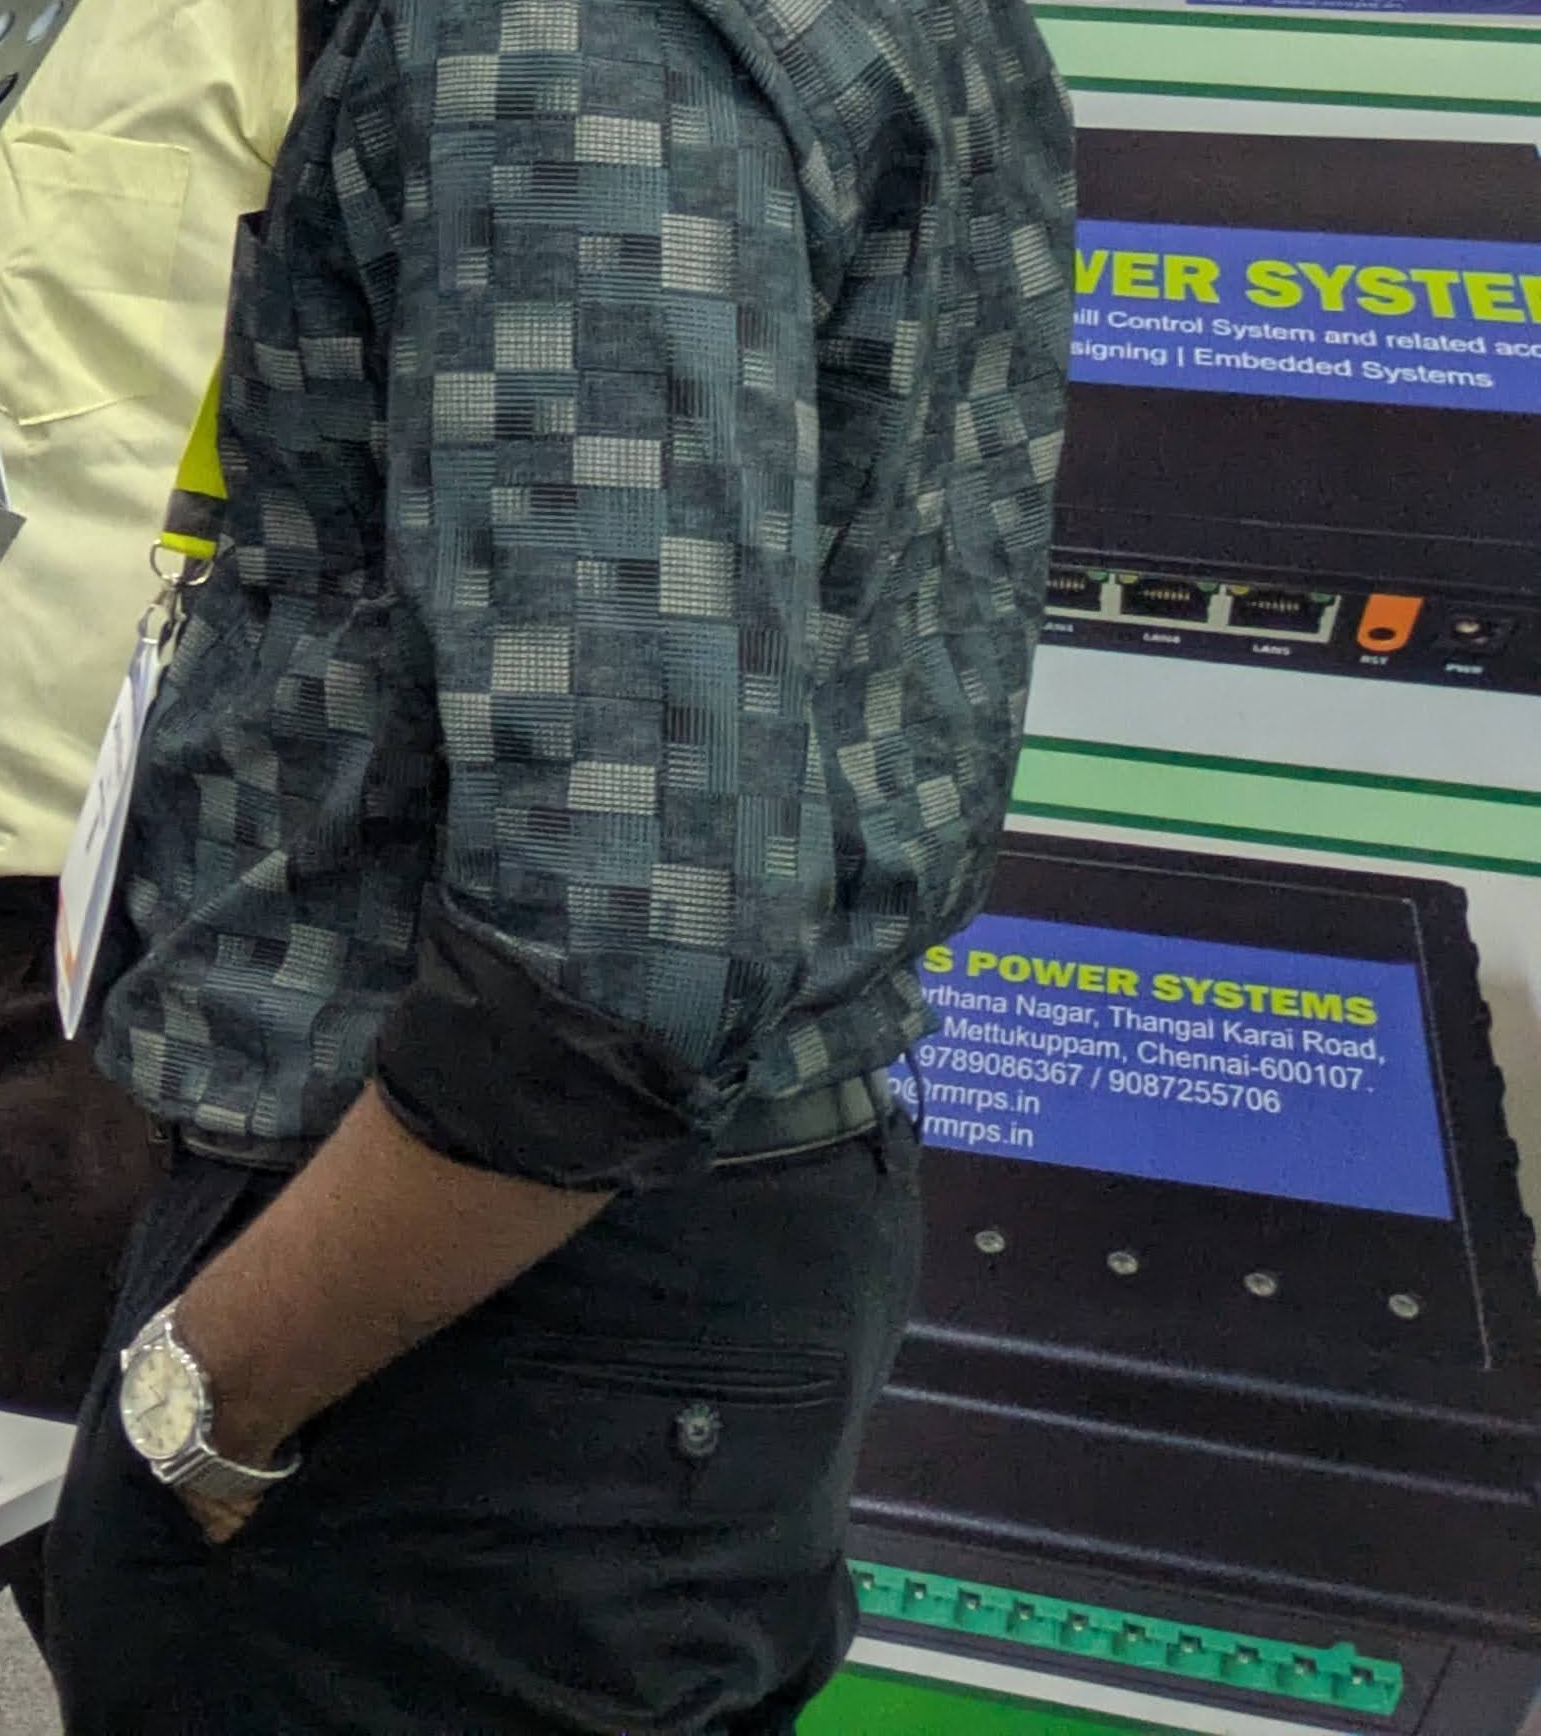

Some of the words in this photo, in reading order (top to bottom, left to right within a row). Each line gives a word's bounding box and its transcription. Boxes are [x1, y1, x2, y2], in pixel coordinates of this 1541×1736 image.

[1073, 306, 1099, 327] ill
[1107, 310, 1204, 335] Control
[1211, 317, 1315, 343] System
[1324, 328, 1377, 348] and
[1385, 331, 1487, 355] related
[1193, 346, 1353, 378] Embedded
[1361, 359, 1495, 390] Systems
[967, 950, 1140, 997] POWER
[1151, 973, 1379, 1027] SYSTEMS
[943, 1016, 1129, 1065] Mettukuppam,
[1015, 993, 1100, 1029] Nagar,
[1108, 1004, 1215, 1043] Thangal
[1222, 1019, 1295, 1051] Karai
[1301, 1029, 1387, 1066] Road,
[1108, 1068, 1282, 1114] 9087255706
